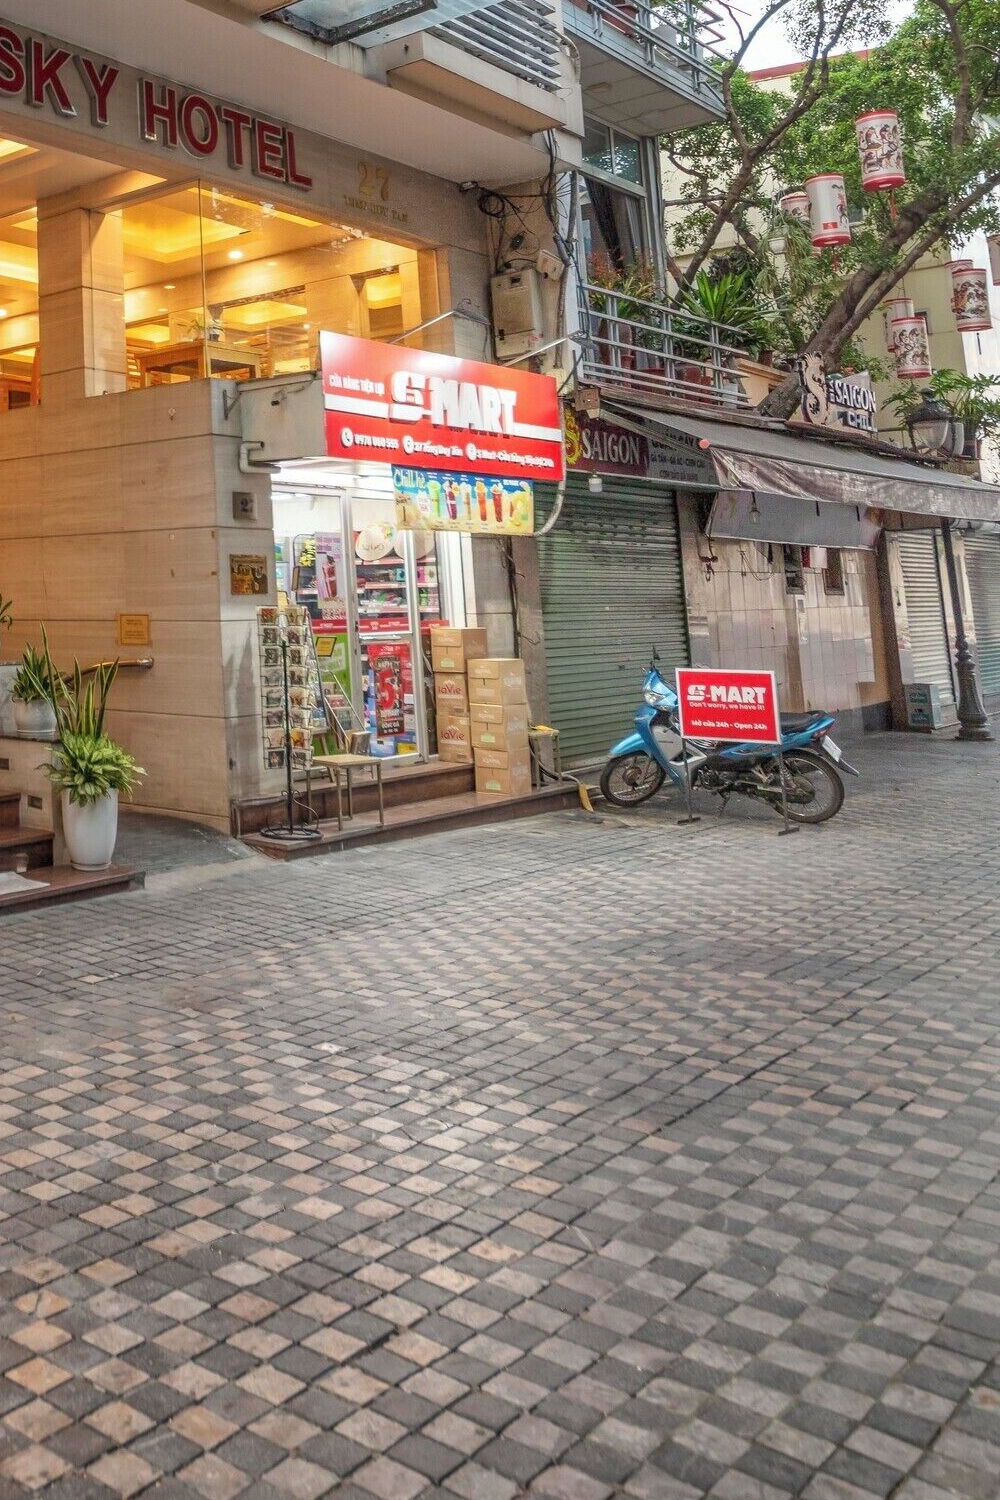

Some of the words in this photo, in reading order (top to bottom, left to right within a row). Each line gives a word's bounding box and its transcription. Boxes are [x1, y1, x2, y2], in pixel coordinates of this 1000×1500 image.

[138, 77, 313, 191] HOTEL
[357, 162, 391, 201] 27
[834, 380, 877, 413] SAIGON
[581, 428, 641, 465] SAIGON
[734, 722, 753, 730] Open
